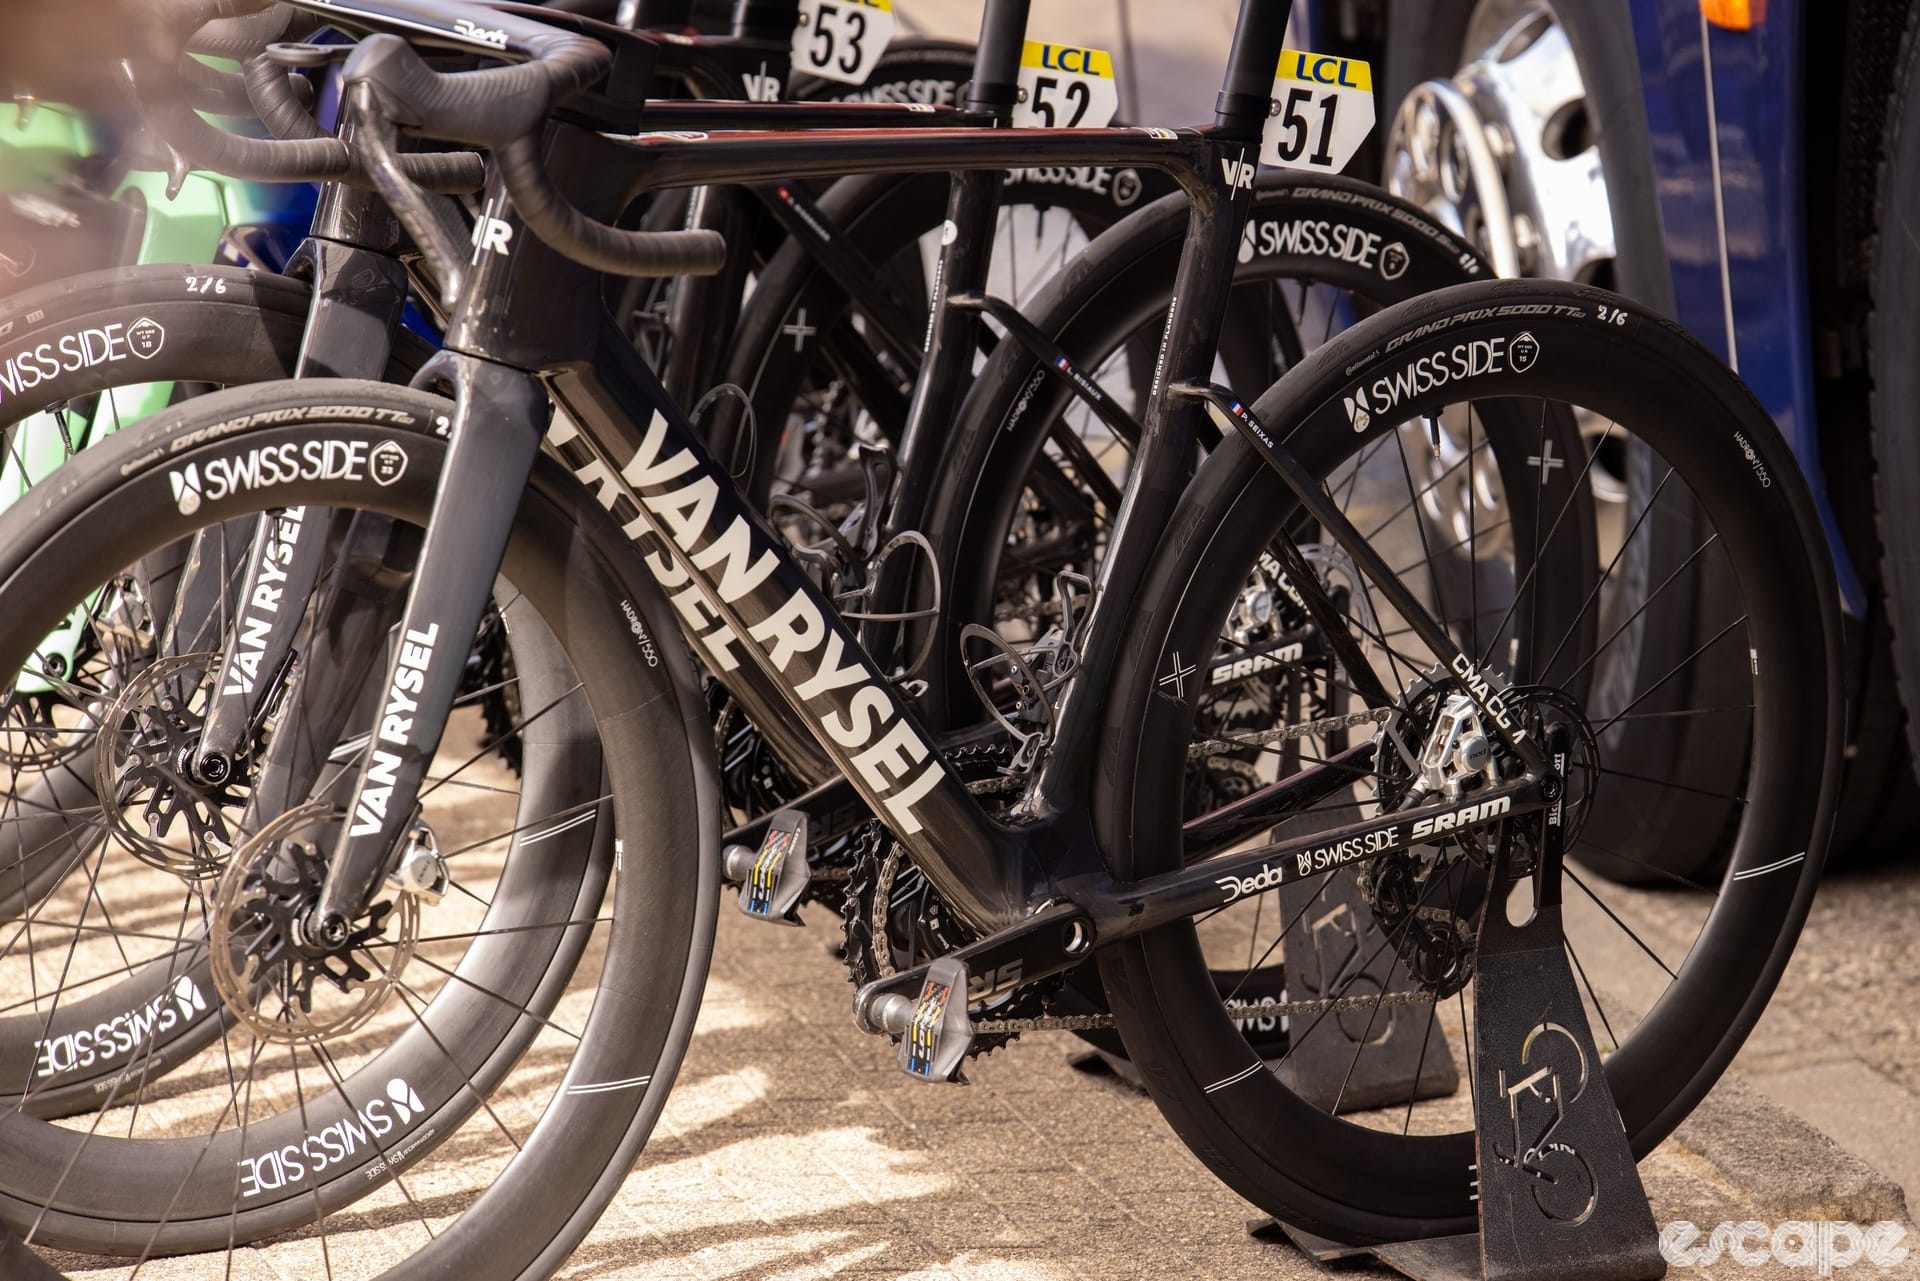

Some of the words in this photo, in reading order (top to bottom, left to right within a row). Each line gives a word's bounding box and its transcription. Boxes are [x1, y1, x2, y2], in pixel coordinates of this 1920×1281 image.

[810, 4, 866, 74] 53
[1042, 45, 1100, 76] LCL
[1296, 54, 1356, 88] LCL
[1032, 76, 1090, 128] 52
[1278, 87, 1339, 167] 51
[1258, 220, 1330, 257] SWISS
[1329, 223, 1382, 269] SIDE
[185, 276, 227, 294] 2/6
[1385, 320, 1450, 353] GRAND
[1449, 306, 1499, 327] PRIX
[1496, 304, 1553, 316] 5000
[1597, 304, 1629, 327] 2/6
[0, 344, 60, 396] WISS
[58, 323, 127, 372] SIDE
[1372, 352, 1450, 415] SWISS
[1450, 337, 1505, 381] SIDE
[170, 415, 251, 452] GRAND
[249, 406, 309, 428] PRIX
[305, 405, 375, 419] 5000
[1240, 413, 1249, 423] P.
[1248, 420, 1274, 449] SEIXAS
[205, 442, 300, 500] SWISS
[301, 440, 369, 480] SIDE
[223, 617, 272, 696] VAN
[251, 505, 306, 612] RYSEL
[620, 407, 782, 604] VAN
[747, 587, 946, 836] RYSEL
[1211, 642, 1303, 686] SRAM
[1451, 652, 1490, 702] CMA
[349, 750, 402, 837] VAN
[378, 622, 440, 746] RYSEL
[1215, 863, 1283, 903] Deda
[1314, 838, 1364, 870] SWISS
[1364, 826, 1399, 854] SIDE
[1411, 795, 1512, 840] SRAM
[968, 959, 1023, 1001] SR
[34, 1030, 96, 1077] SIDE
[94, 995, 177, 1060] SWISS
[303, 1099, 393, 1172] SWISS
[237, 1145, 304, 1197] SIDE
